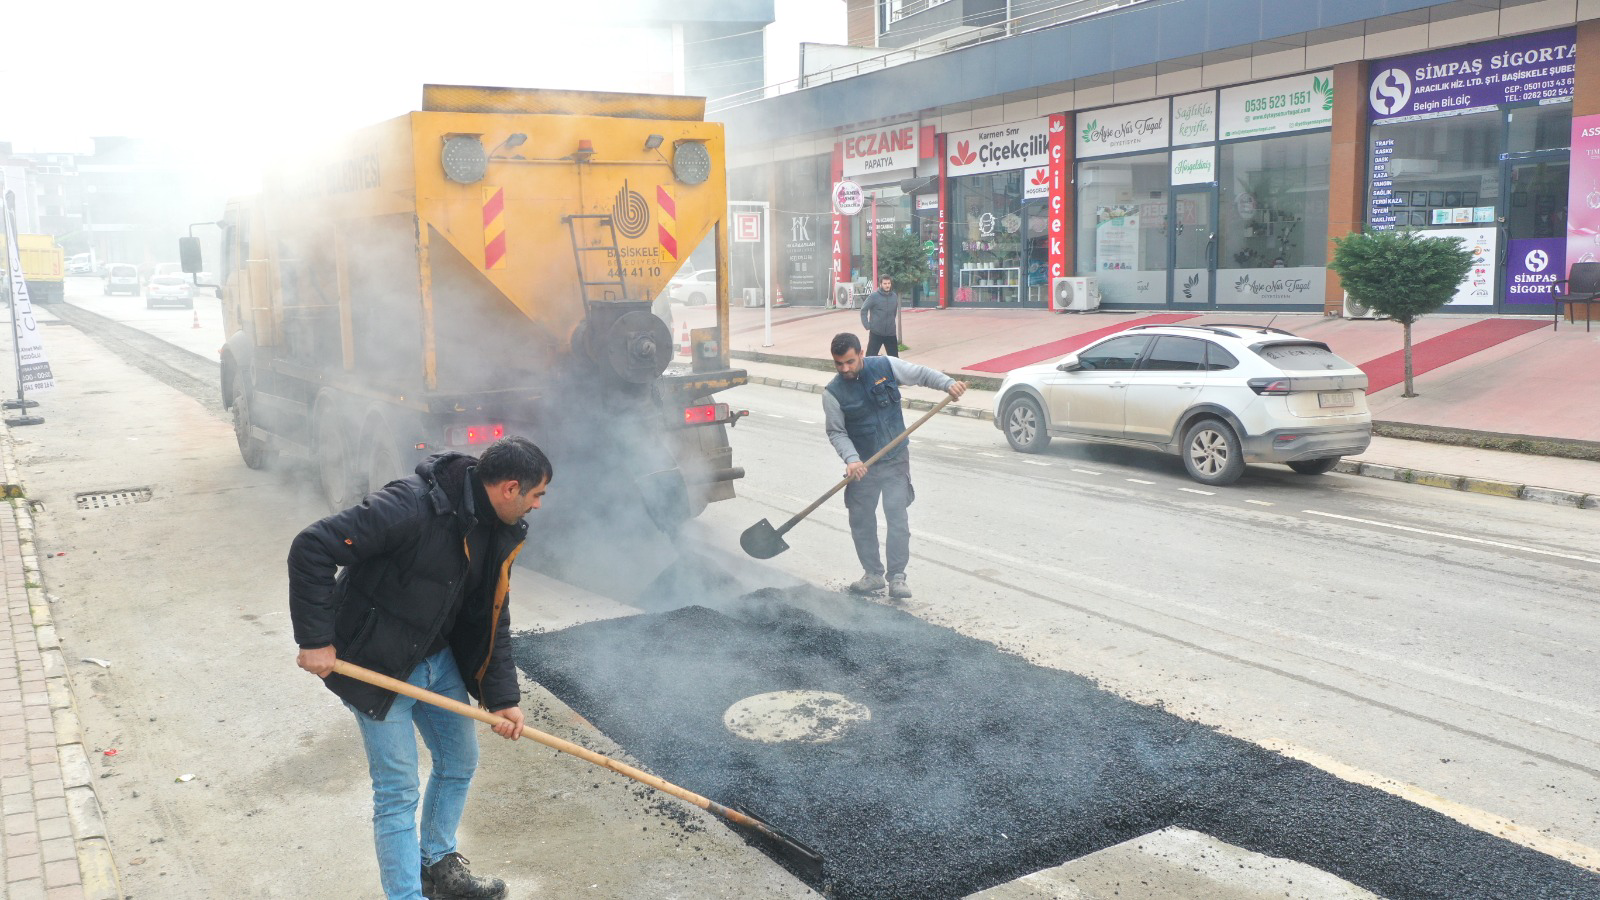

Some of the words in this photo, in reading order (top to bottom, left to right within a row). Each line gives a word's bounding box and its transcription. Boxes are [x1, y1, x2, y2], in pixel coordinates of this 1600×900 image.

[1415, 58, 1482, 81] SİMPAŞ
[1414, 82, 1449, 94] ARACILIK
[1466, 76, 1483, 87] LTD.
[1485, 73, 1500, 85] ŞTİ.
[1501, 67, 1548, 82] BAŞİSKELE
[1504, 86, 1523, 94] CEP:
[1523, 82, 1541, 91] 0501
[1541, 80, 1555, 89] 013
[1555, 78, 1566, 86] 43
[1245, 97, 1268, 113] 0535
[1269, 94, 1287, 109] 523
[1289, 90, 1312, 106] 1551
[1413, 99, 1440, 112] Belgin
[1441, 93, 1472, 107] BİLGİÇ
[1504, 94, 1523, 103] TEL:
[978, 130, 1005, 142] Karmen
[1005, 127, 1021, 137] Smr
[1114, 120, 1139, 139] Nur
[1139, 116, 1164, 136] Tugal
[845, 126, 914, 160] ECZANE
[978, 133, 1050, 168] Çiçekçilik
[864, 157, 894, 170] PAPATYA
[630, 267, 644, 278] 41
[648, 266, 661, 277] 10
